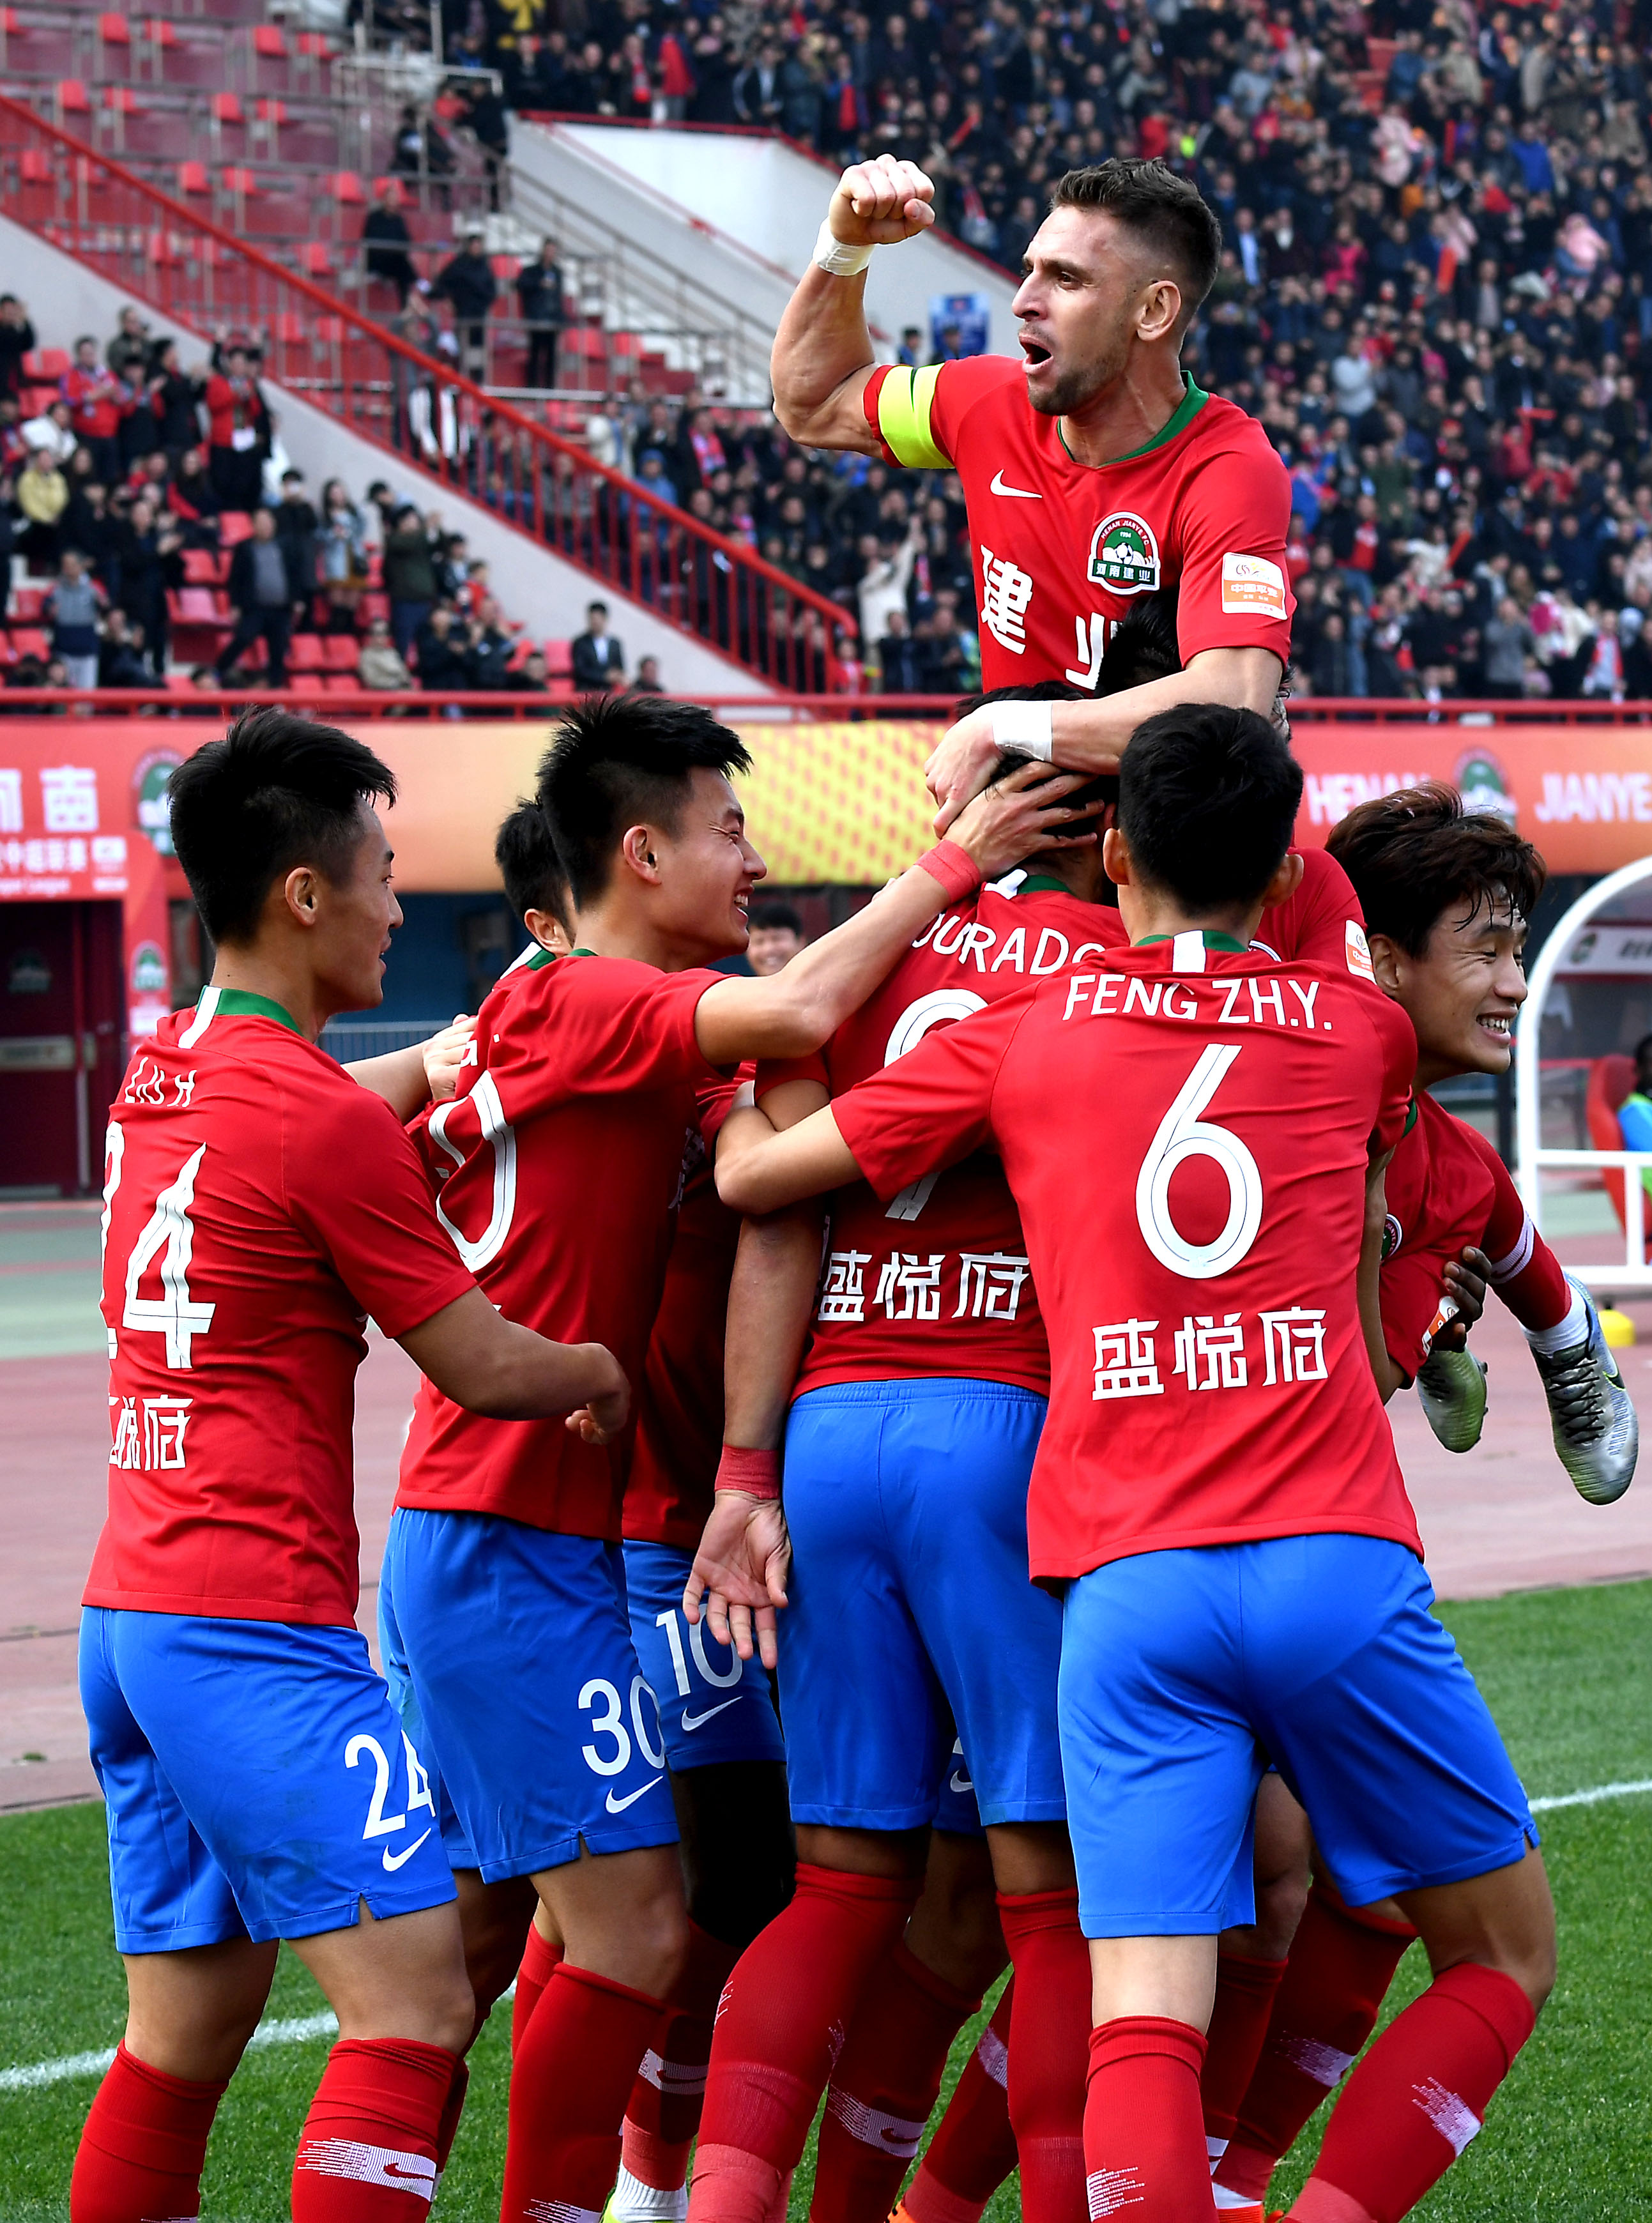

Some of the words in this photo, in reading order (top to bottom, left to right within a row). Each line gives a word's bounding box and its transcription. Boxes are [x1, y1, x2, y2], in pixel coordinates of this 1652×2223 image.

[1096, 563, 1151, 582] 河南建业
[1534, 772, 1652, 823] JIANYE
[1062, 974, 1198, 1021] FENG
[1212, 978, 1333, 1030] ZH.Y.
[1136, 1043, 1263, 1279] 6
[818, 1249, 1030, 1322] 盛悦府
[1092, 1306, 1329, 1400] 盛悦府
[109, 1394, 193, 1471] 悦府
[655, 1603, 743, 1696] 10
[577, 1675, 665, 1776] 30
[344, 1729, 436, 1840] 24
